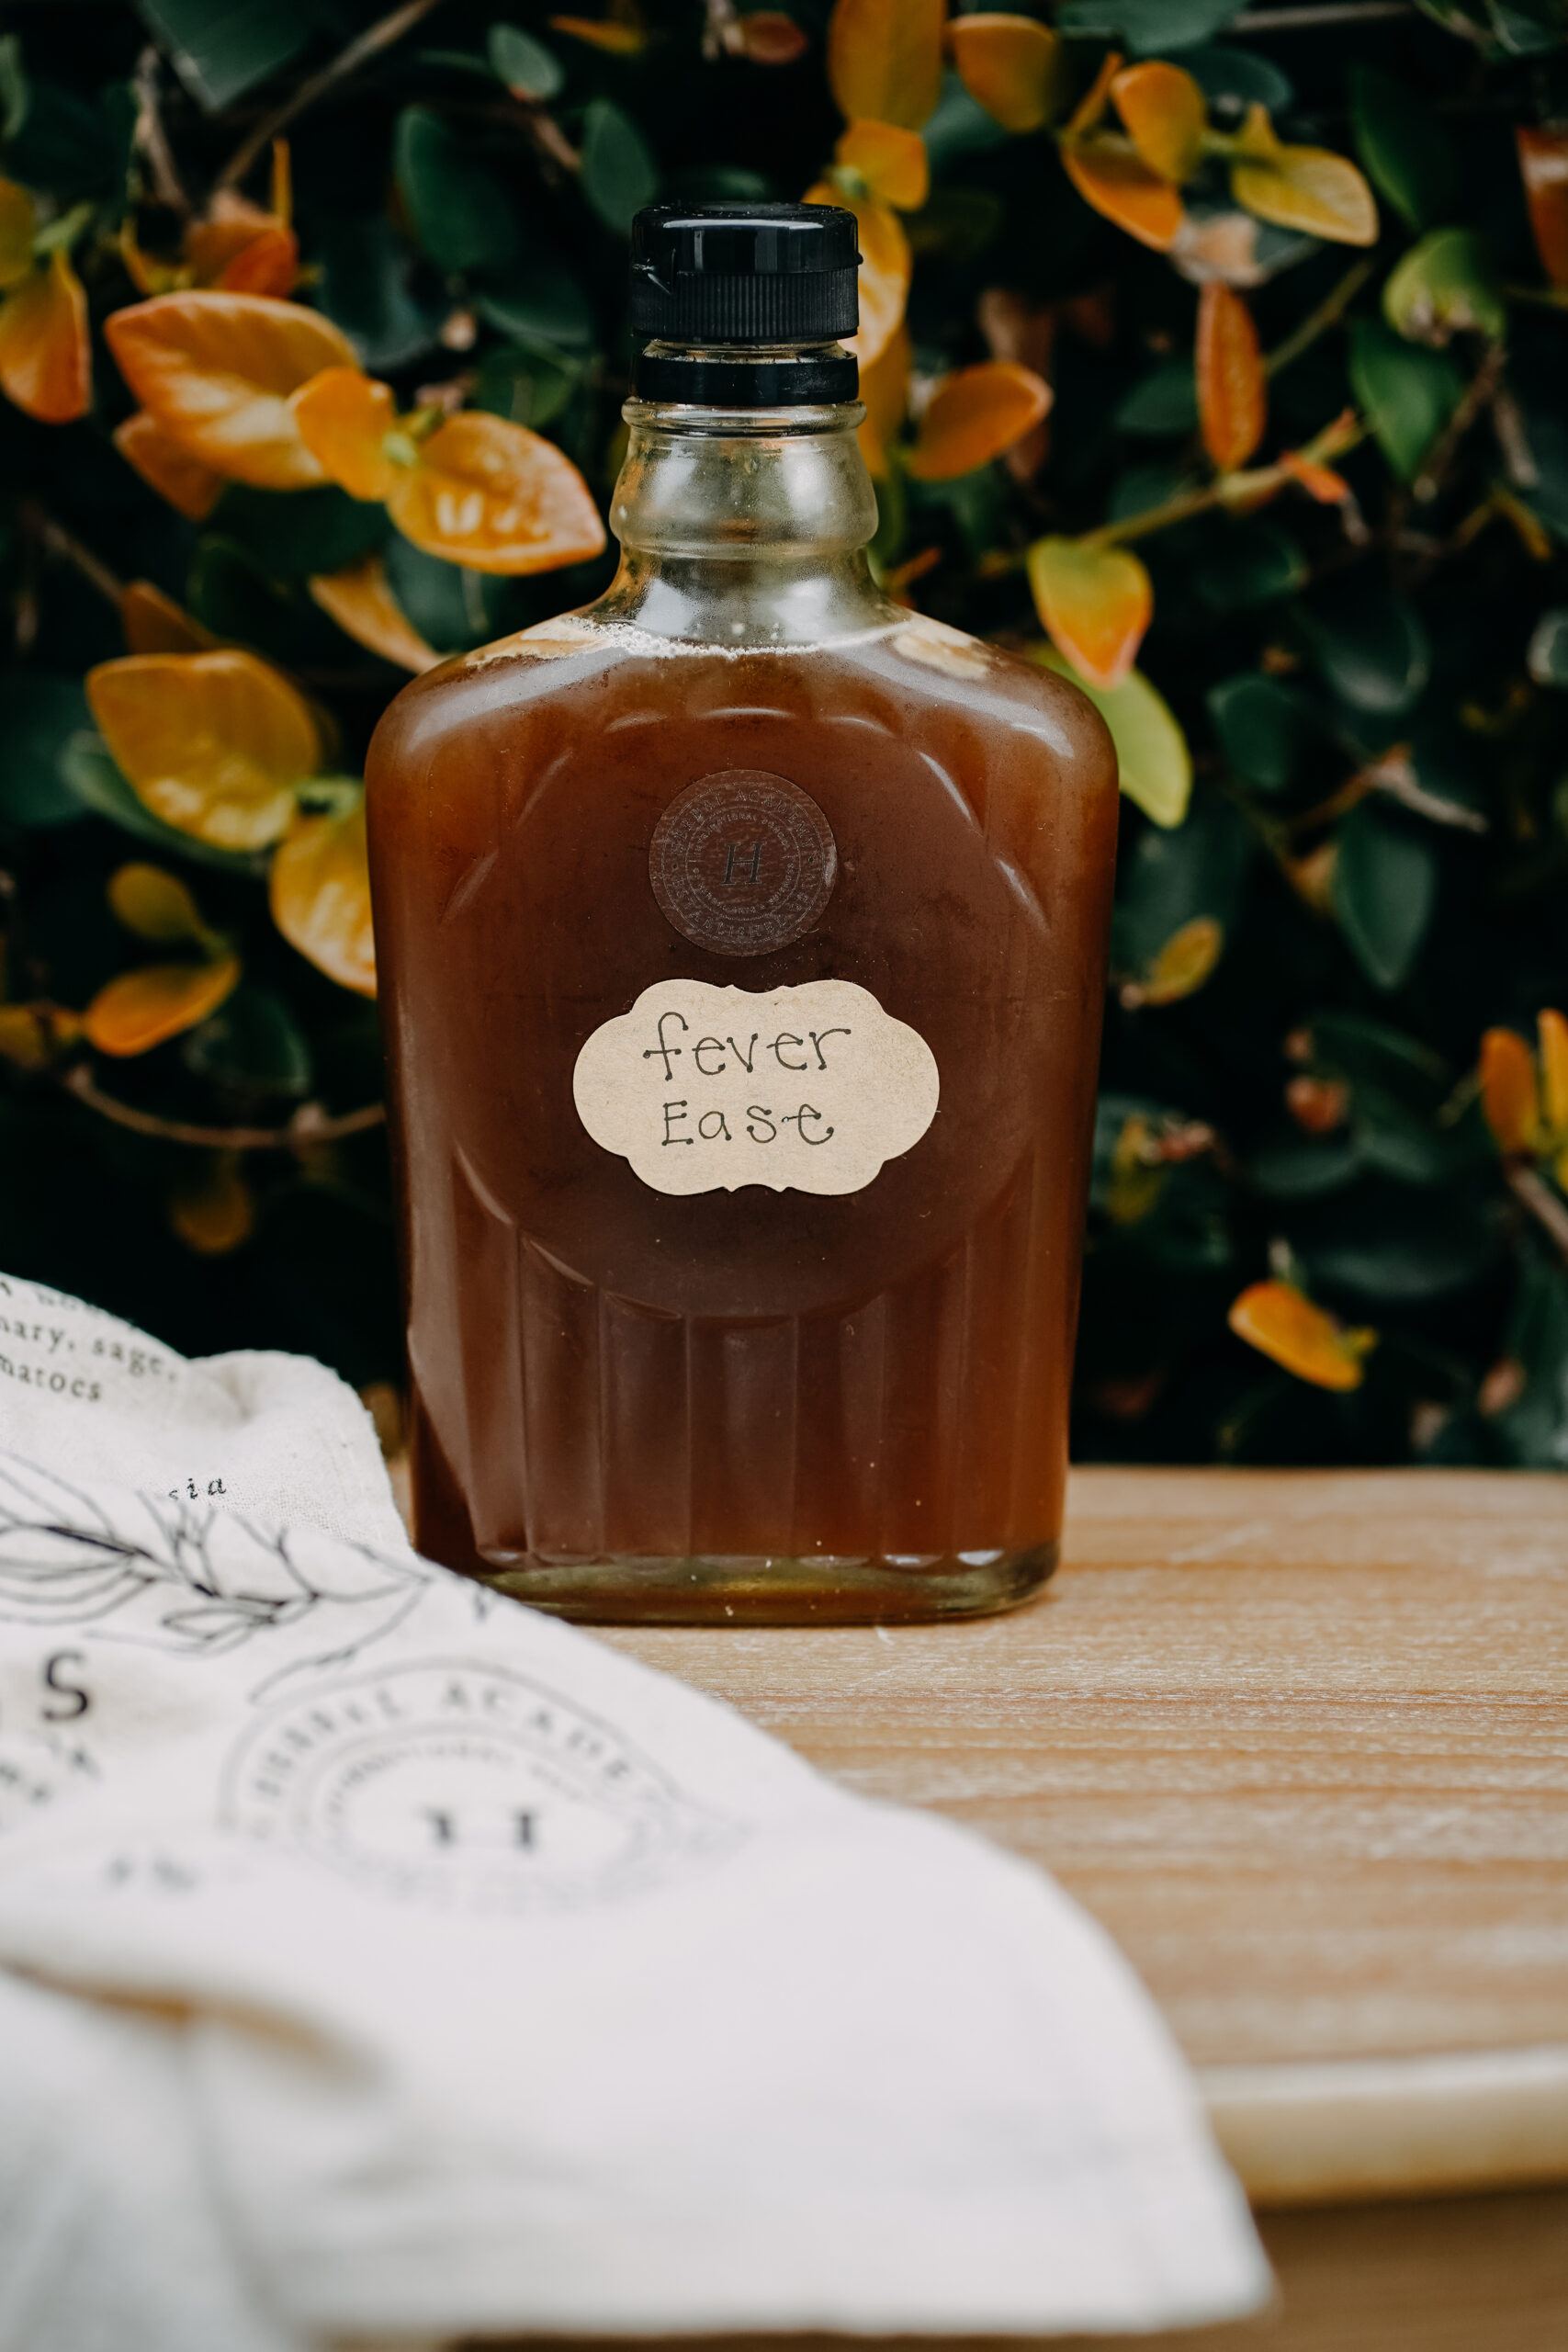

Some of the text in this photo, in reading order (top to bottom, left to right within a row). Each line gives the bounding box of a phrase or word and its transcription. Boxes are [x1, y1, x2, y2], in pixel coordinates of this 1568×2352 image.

[720, 841, 766, 886] H
[643, 1012, 852, 1080] fever
[661, 1100, 834, 1146] Ease
